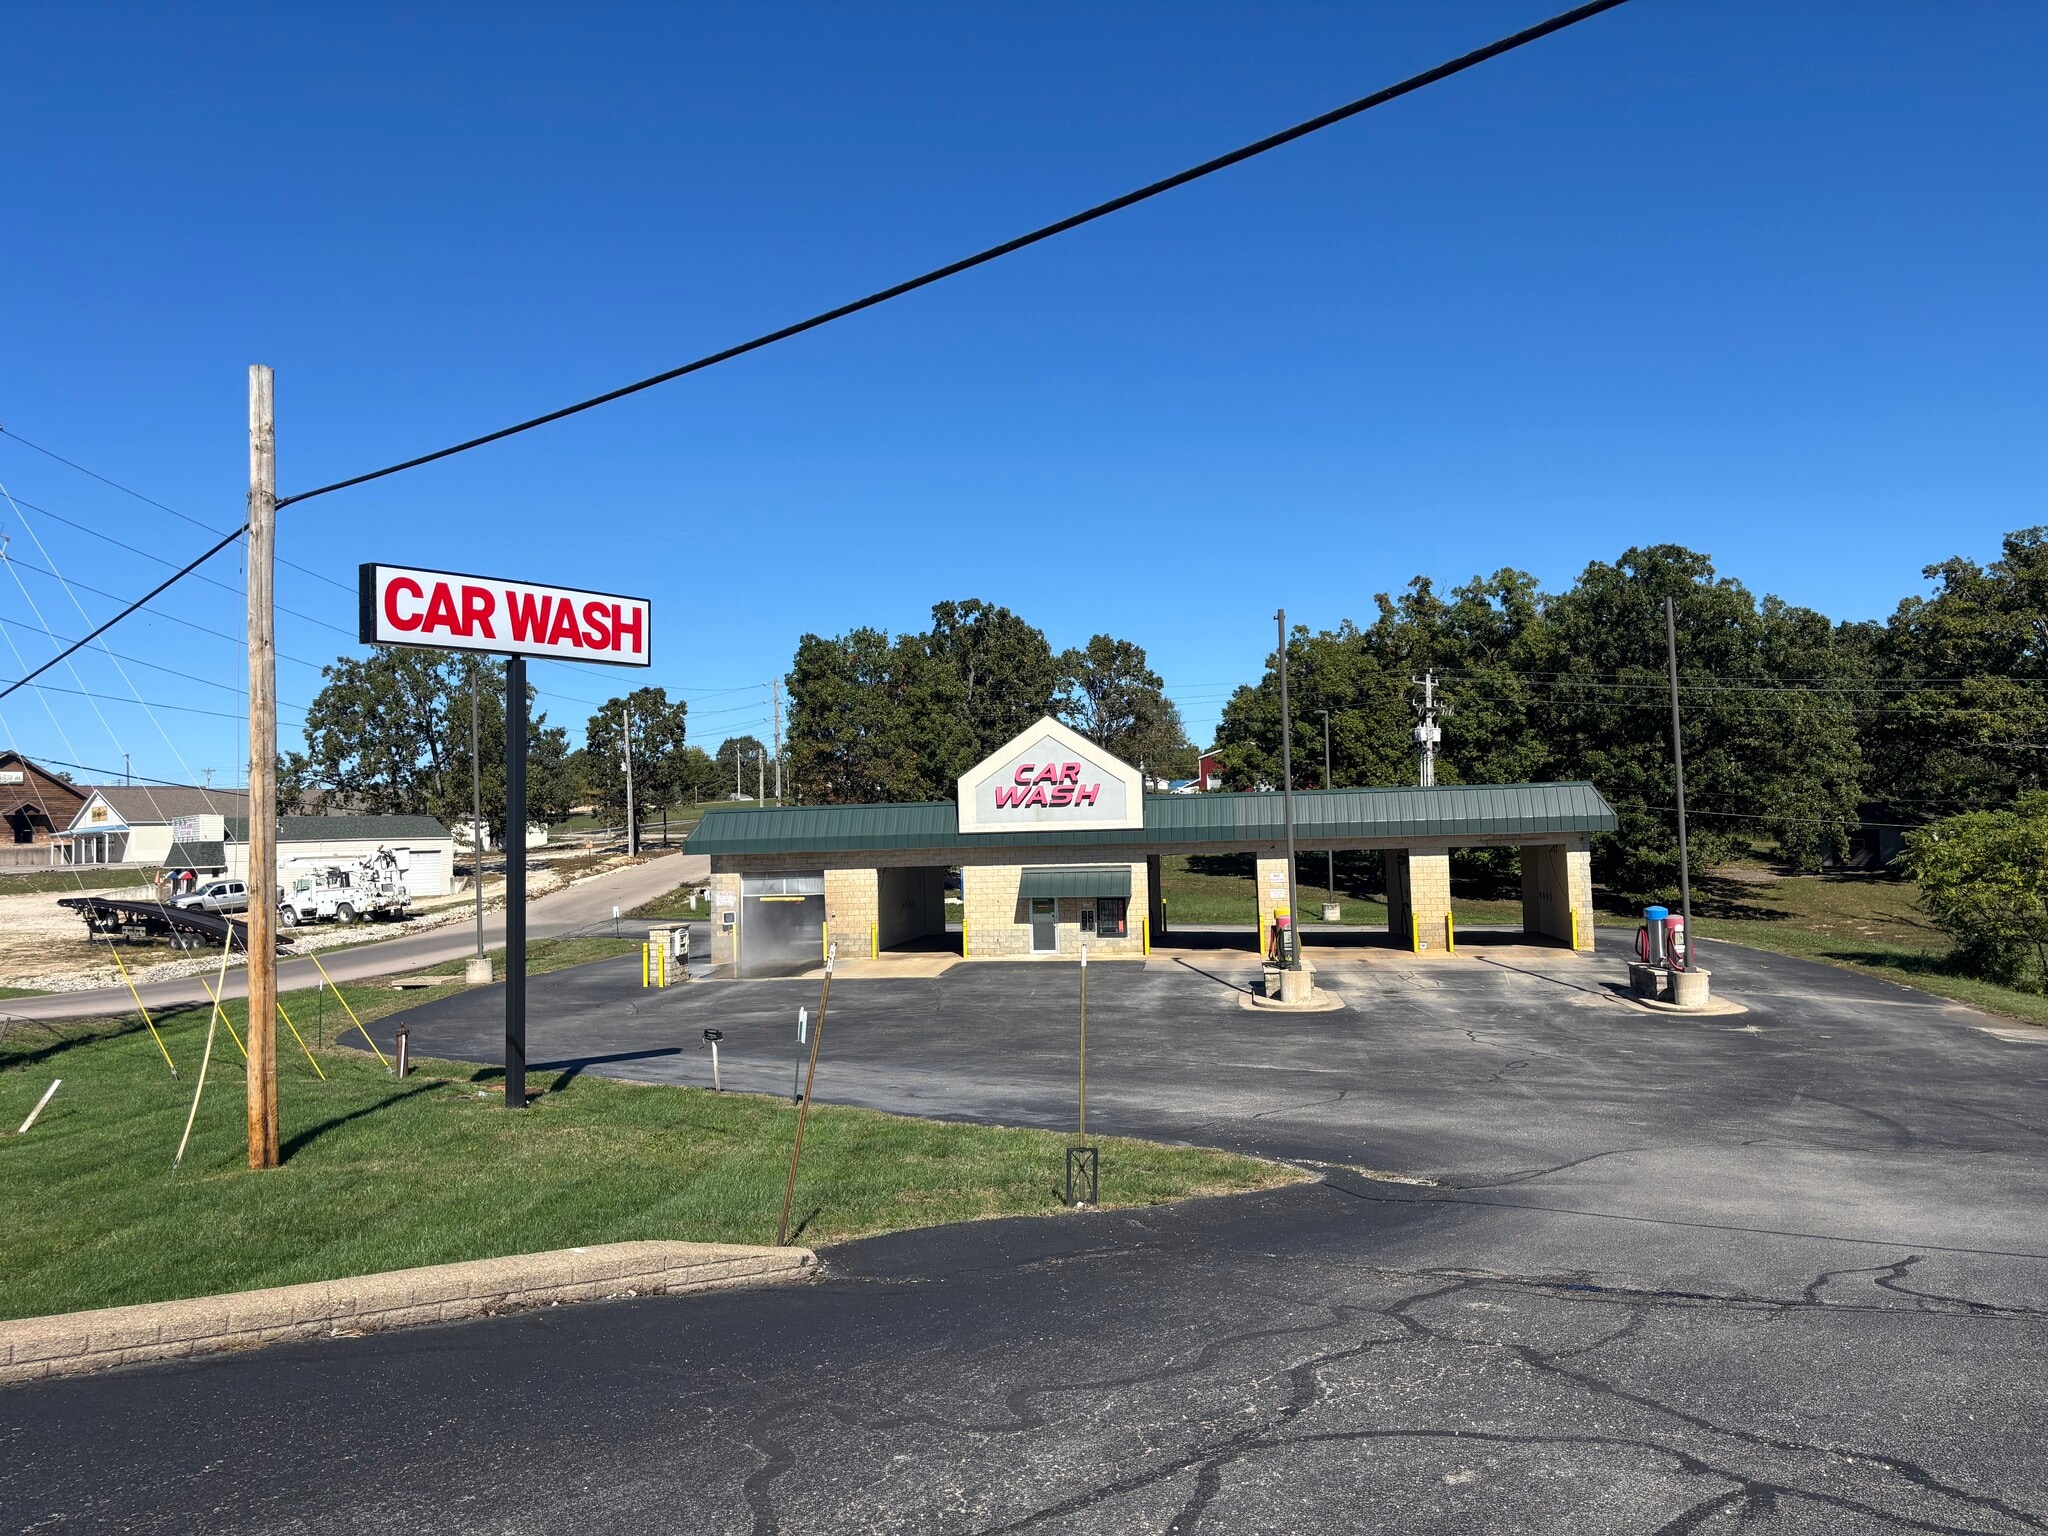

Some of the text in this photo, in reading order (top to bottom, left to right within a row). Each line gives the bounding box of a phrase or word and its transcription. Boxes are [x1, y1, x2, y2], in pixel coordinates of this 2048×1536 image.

[384, 576, 642, 654] CAR WASH
[1014, 762, 1081, 785] CAR
[995, 783, 1101, 809] WASH
